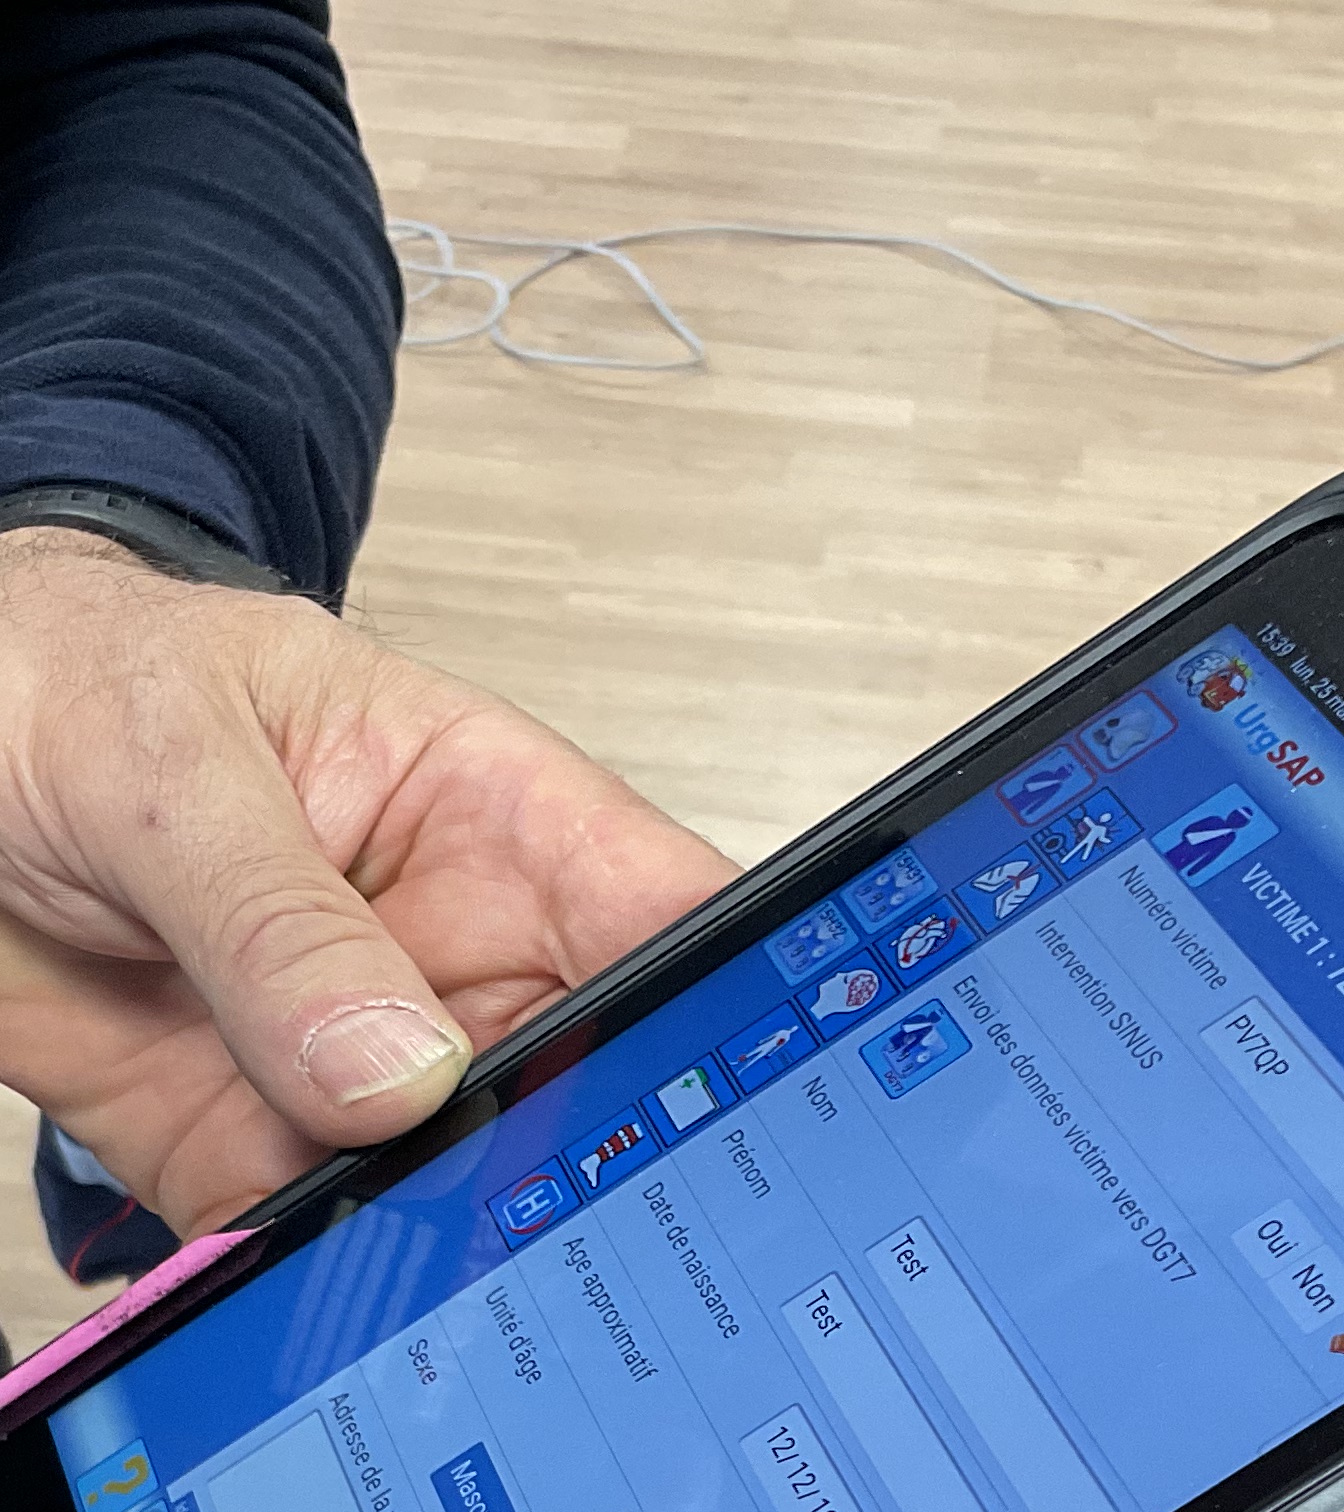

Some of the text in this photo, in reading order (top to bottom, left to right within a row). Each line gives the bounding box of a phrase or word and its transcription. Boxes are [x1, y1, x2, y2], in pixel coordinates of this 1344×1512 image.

[1311, 677, 1337, 698] 25
[1234, 704, 1326, 788] UrgSAP
[1118, 865, 1229, 991] Numéro victime
[1241, 862, 1321, 944] VICTIME
[1306, 937, 1330, 956] 1
[1036, 920, 1163, 1070] Intervention SINUS
[1225, 1014, 1290, 1077] PV7QP
[801, 1075, 839, 1123] Nom
[952, 975, 1197, 1282] Envoi des données victime vers DGT7
[721, 1129, 772, 1200] Prénom
[642, 1182, 741, 1340] Date de naissance
[890, 1234, 930, 1282] Test
[1257, 1219, 1299, 1259] Oui
[562, 1237, 659, 1383] Age approximatif
[805, 1289, 843, 1338] Test
[1292, 1263, 1335, 1314] Non
[407, 1338, 438, 1387] Sexe
[485, 1285, 542, 1386] Unité d'âge
[328, 1391, 371, 1467] Adresse
[360, 1464, 382, 1493] de
[370, 1488, 387, 1512] la
